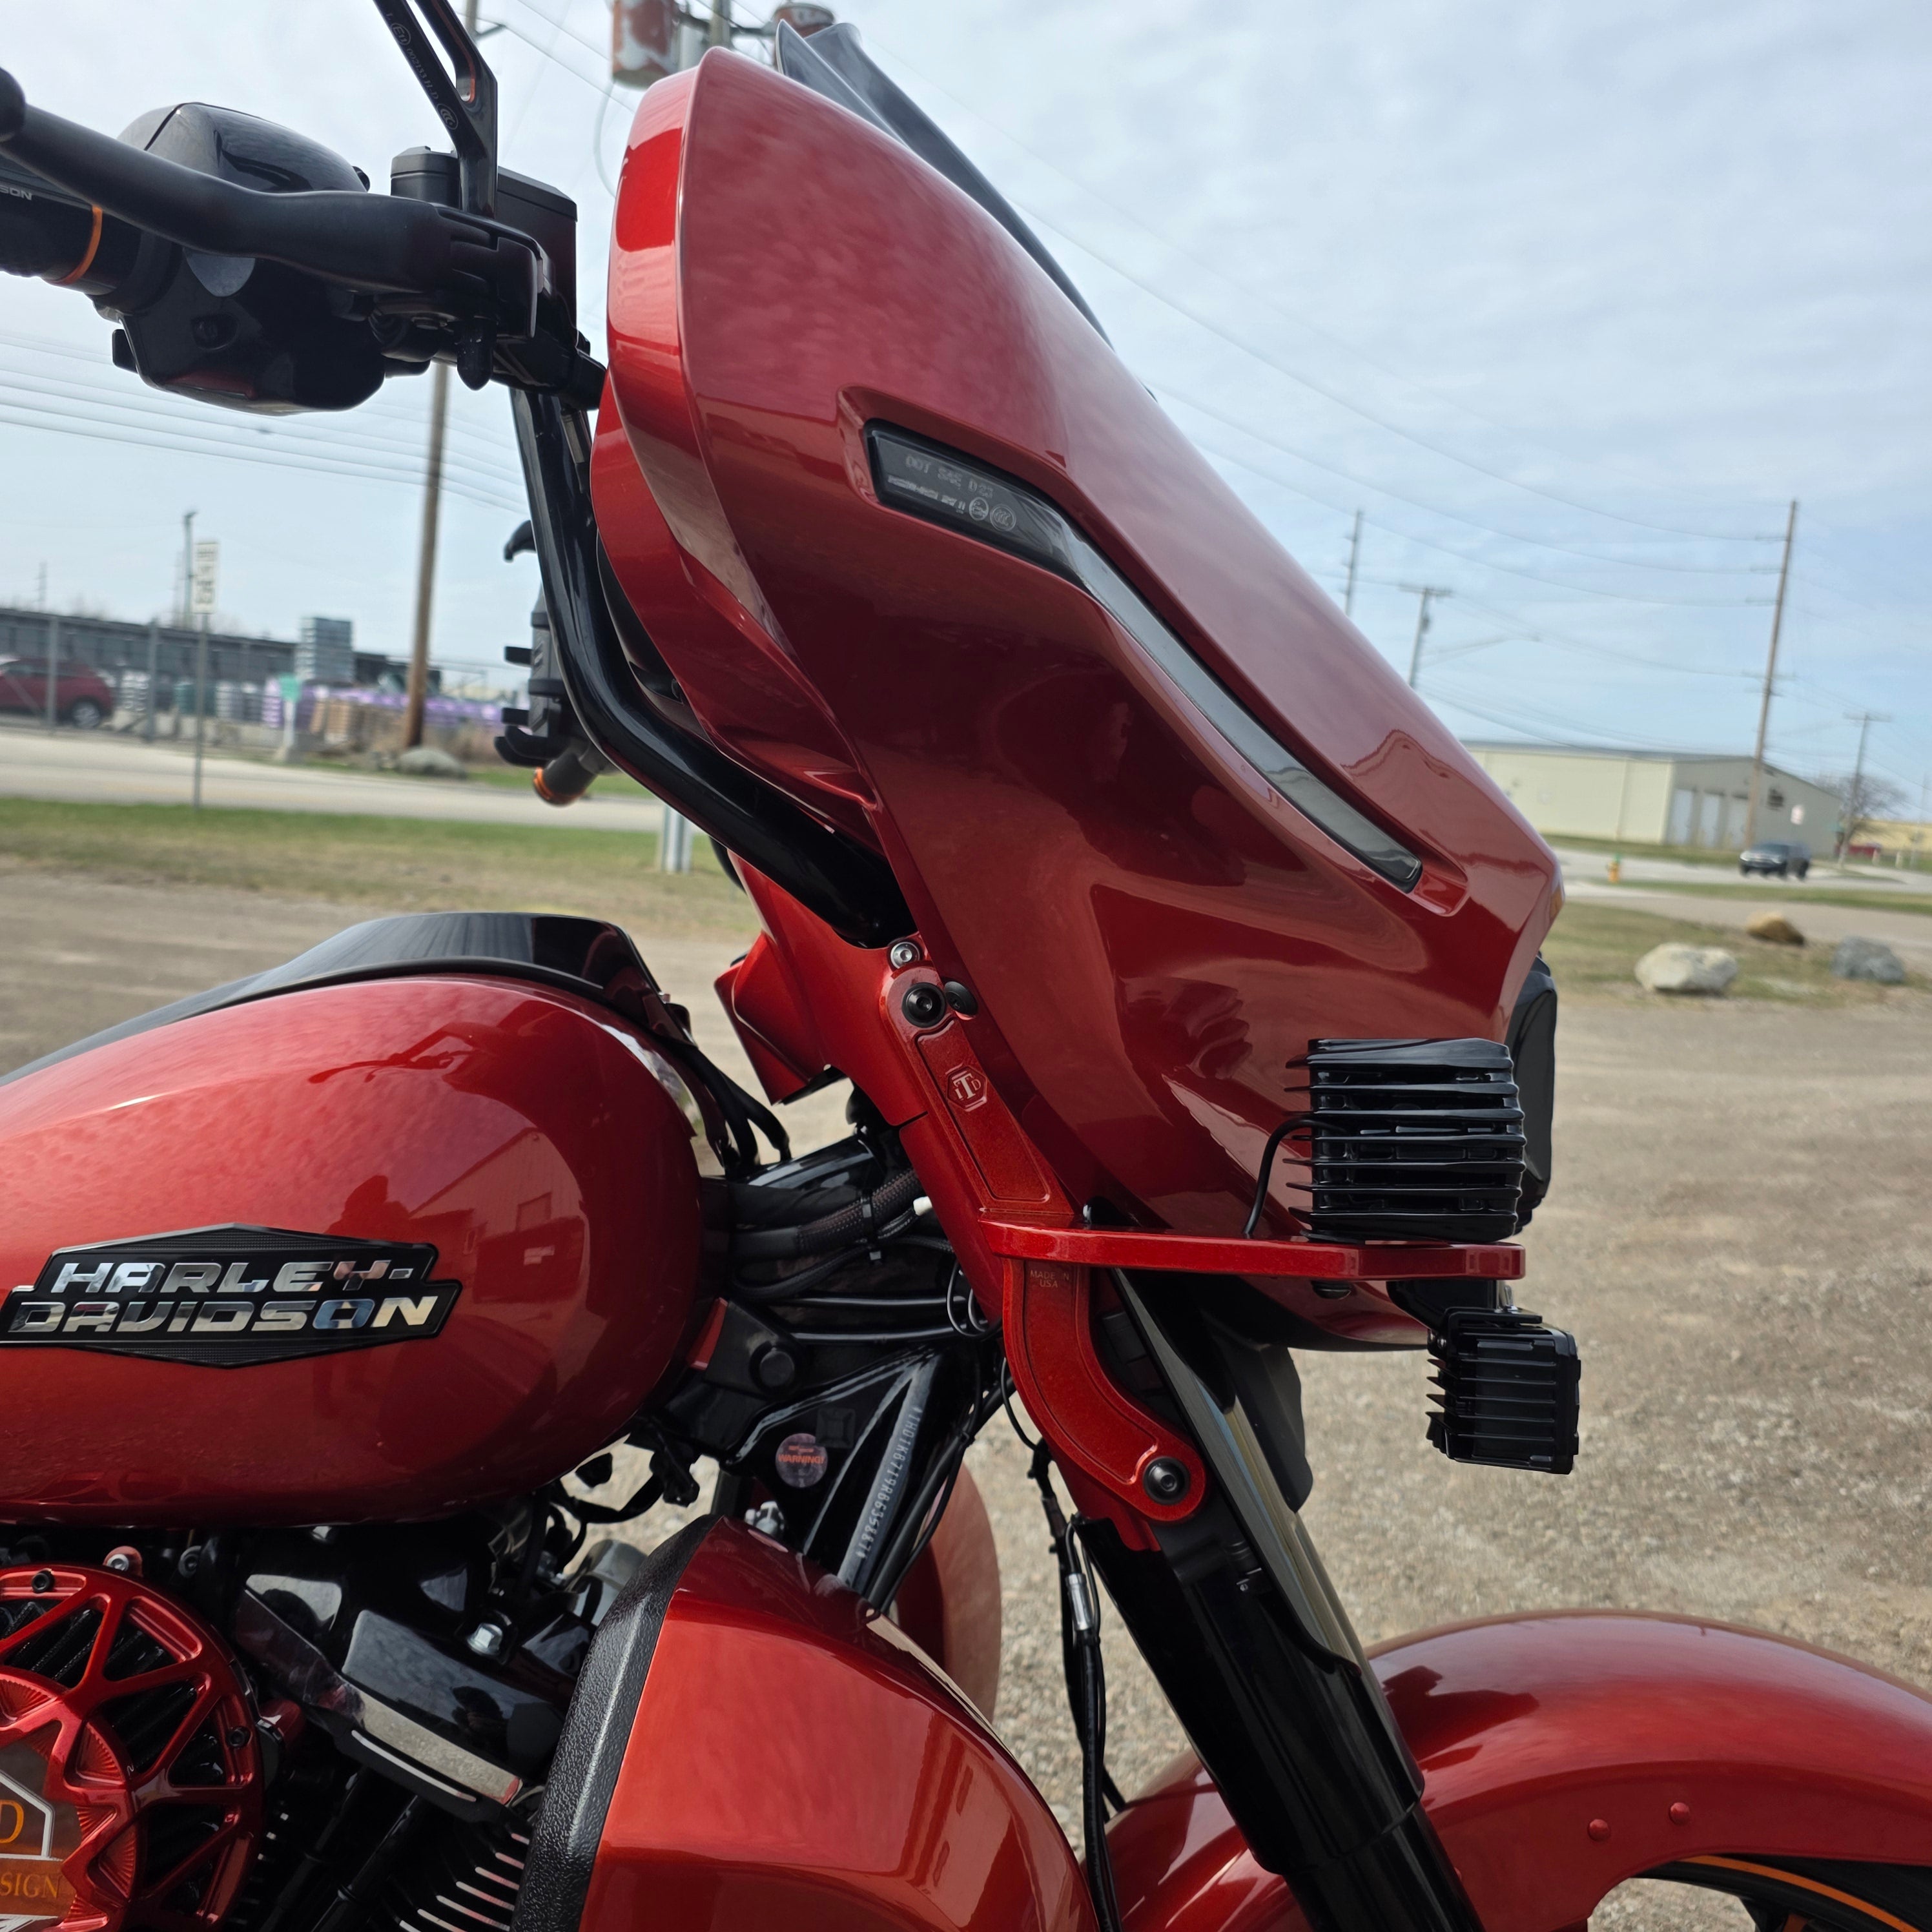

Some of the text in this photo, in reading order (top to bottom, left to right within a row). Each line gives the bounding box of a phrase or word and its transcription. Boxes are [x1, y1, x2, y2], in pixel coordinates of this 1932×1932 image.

[51, 1260, 413, 1294] HARLEY-
[1030, 1270, 1056, 1279] MADE
[1040, 1279, 1058, 1288] USA
[7, 1295, 438, 1333] DAVIDSON
[777, 1454, 825, 1464] WARNING!
[0, 1872, 63, 1899] SIGN
